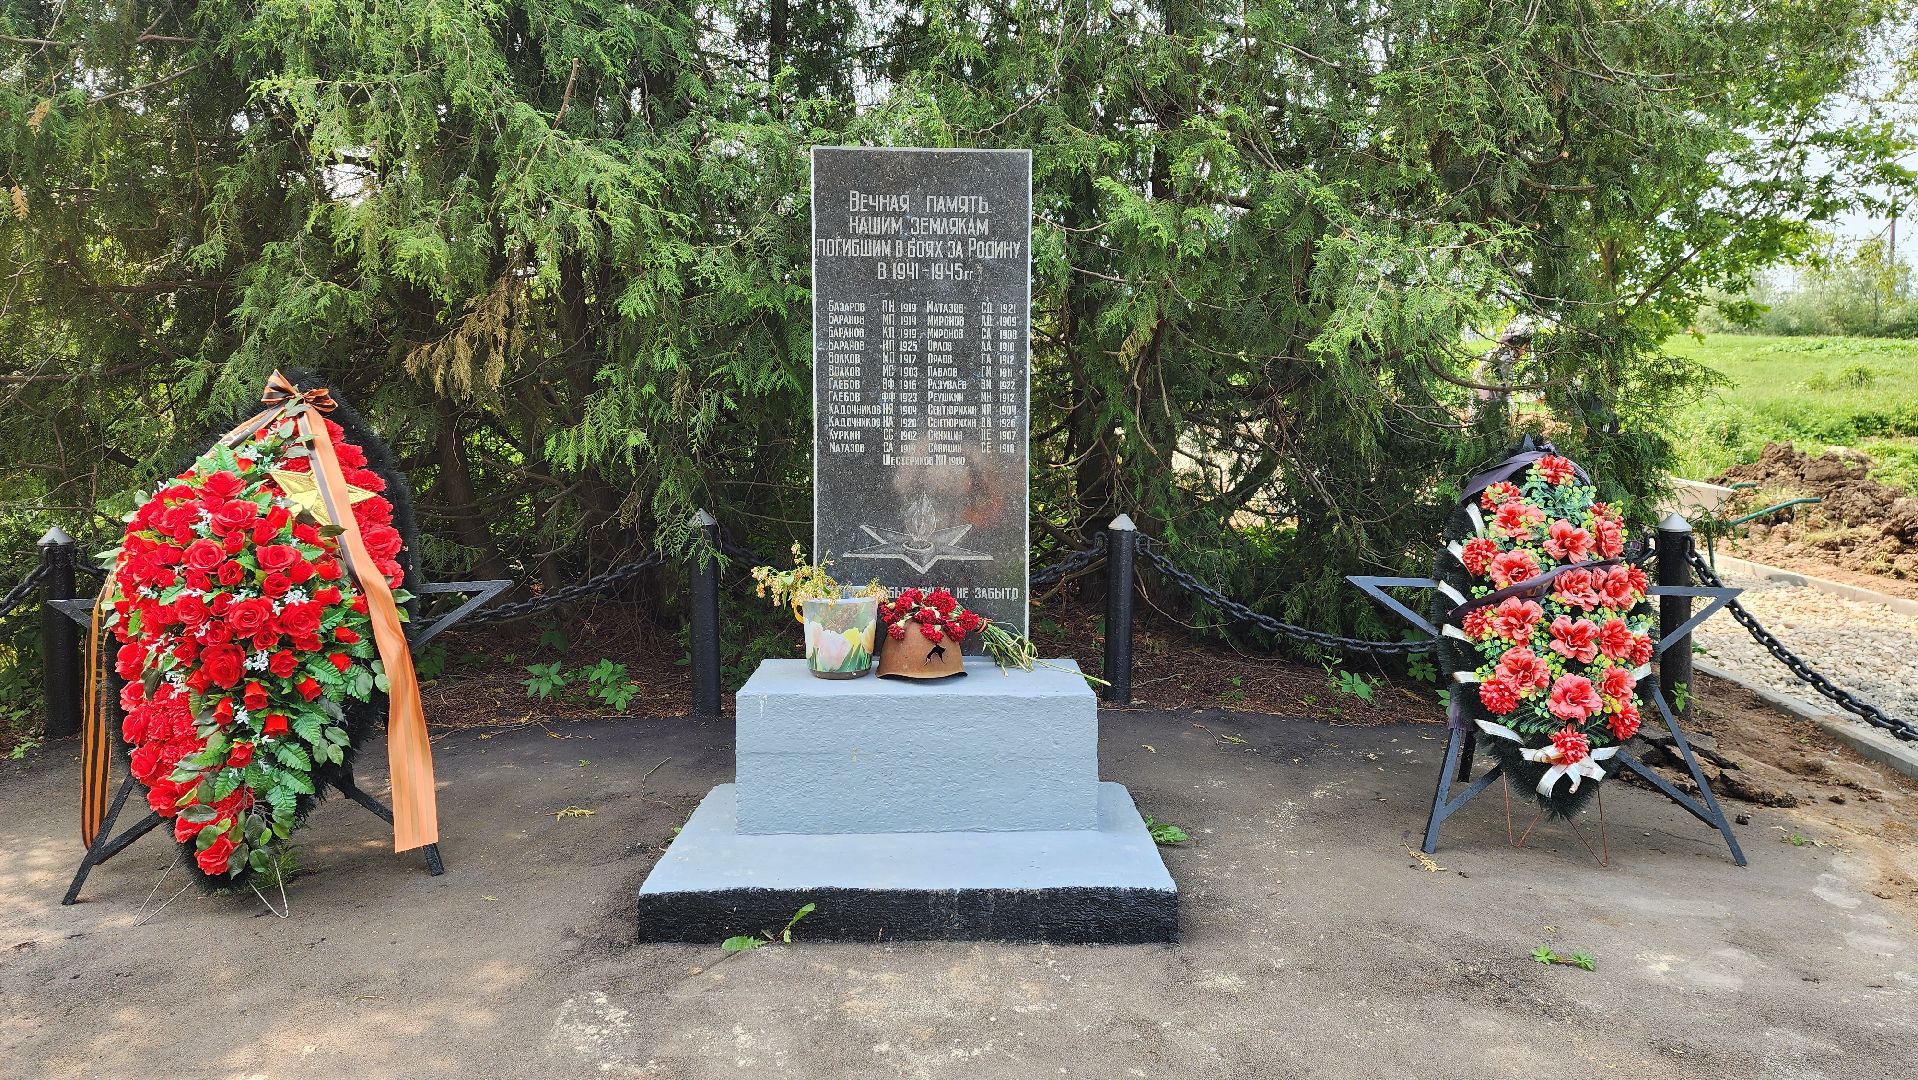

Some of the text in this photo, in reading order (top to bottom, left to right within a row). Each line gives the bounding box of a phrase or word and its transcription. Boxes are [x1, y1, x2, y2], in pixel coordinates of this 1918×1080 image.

[926, 195, 989, 213] ПАМЯТЬ
[849, 216, 989, 235] НАШИМ ЗЕМЛЯКАМ
[817, 238, 891, 257] ПОГИБШИМ
[896, 239, 902, 257] В
[907, 240, 943, 258] БОЯХ
[948, 241, 963, 258] ЗА
[878, 263, 887, 280] В
[1000, 303, 1016, 313] 1921
[900, 341, 917, 351] 1925
[900, 354, 916, 363] 1917
[1000, 355, 1015, 364] 1912
[928, 366, 958, 377] ПАВЛОВ
[1000, 431, 1016, 440] 1907
[957, 587, 968, 599] НЕ
[974, 587, 1019, 600] ЗАБЫТО
